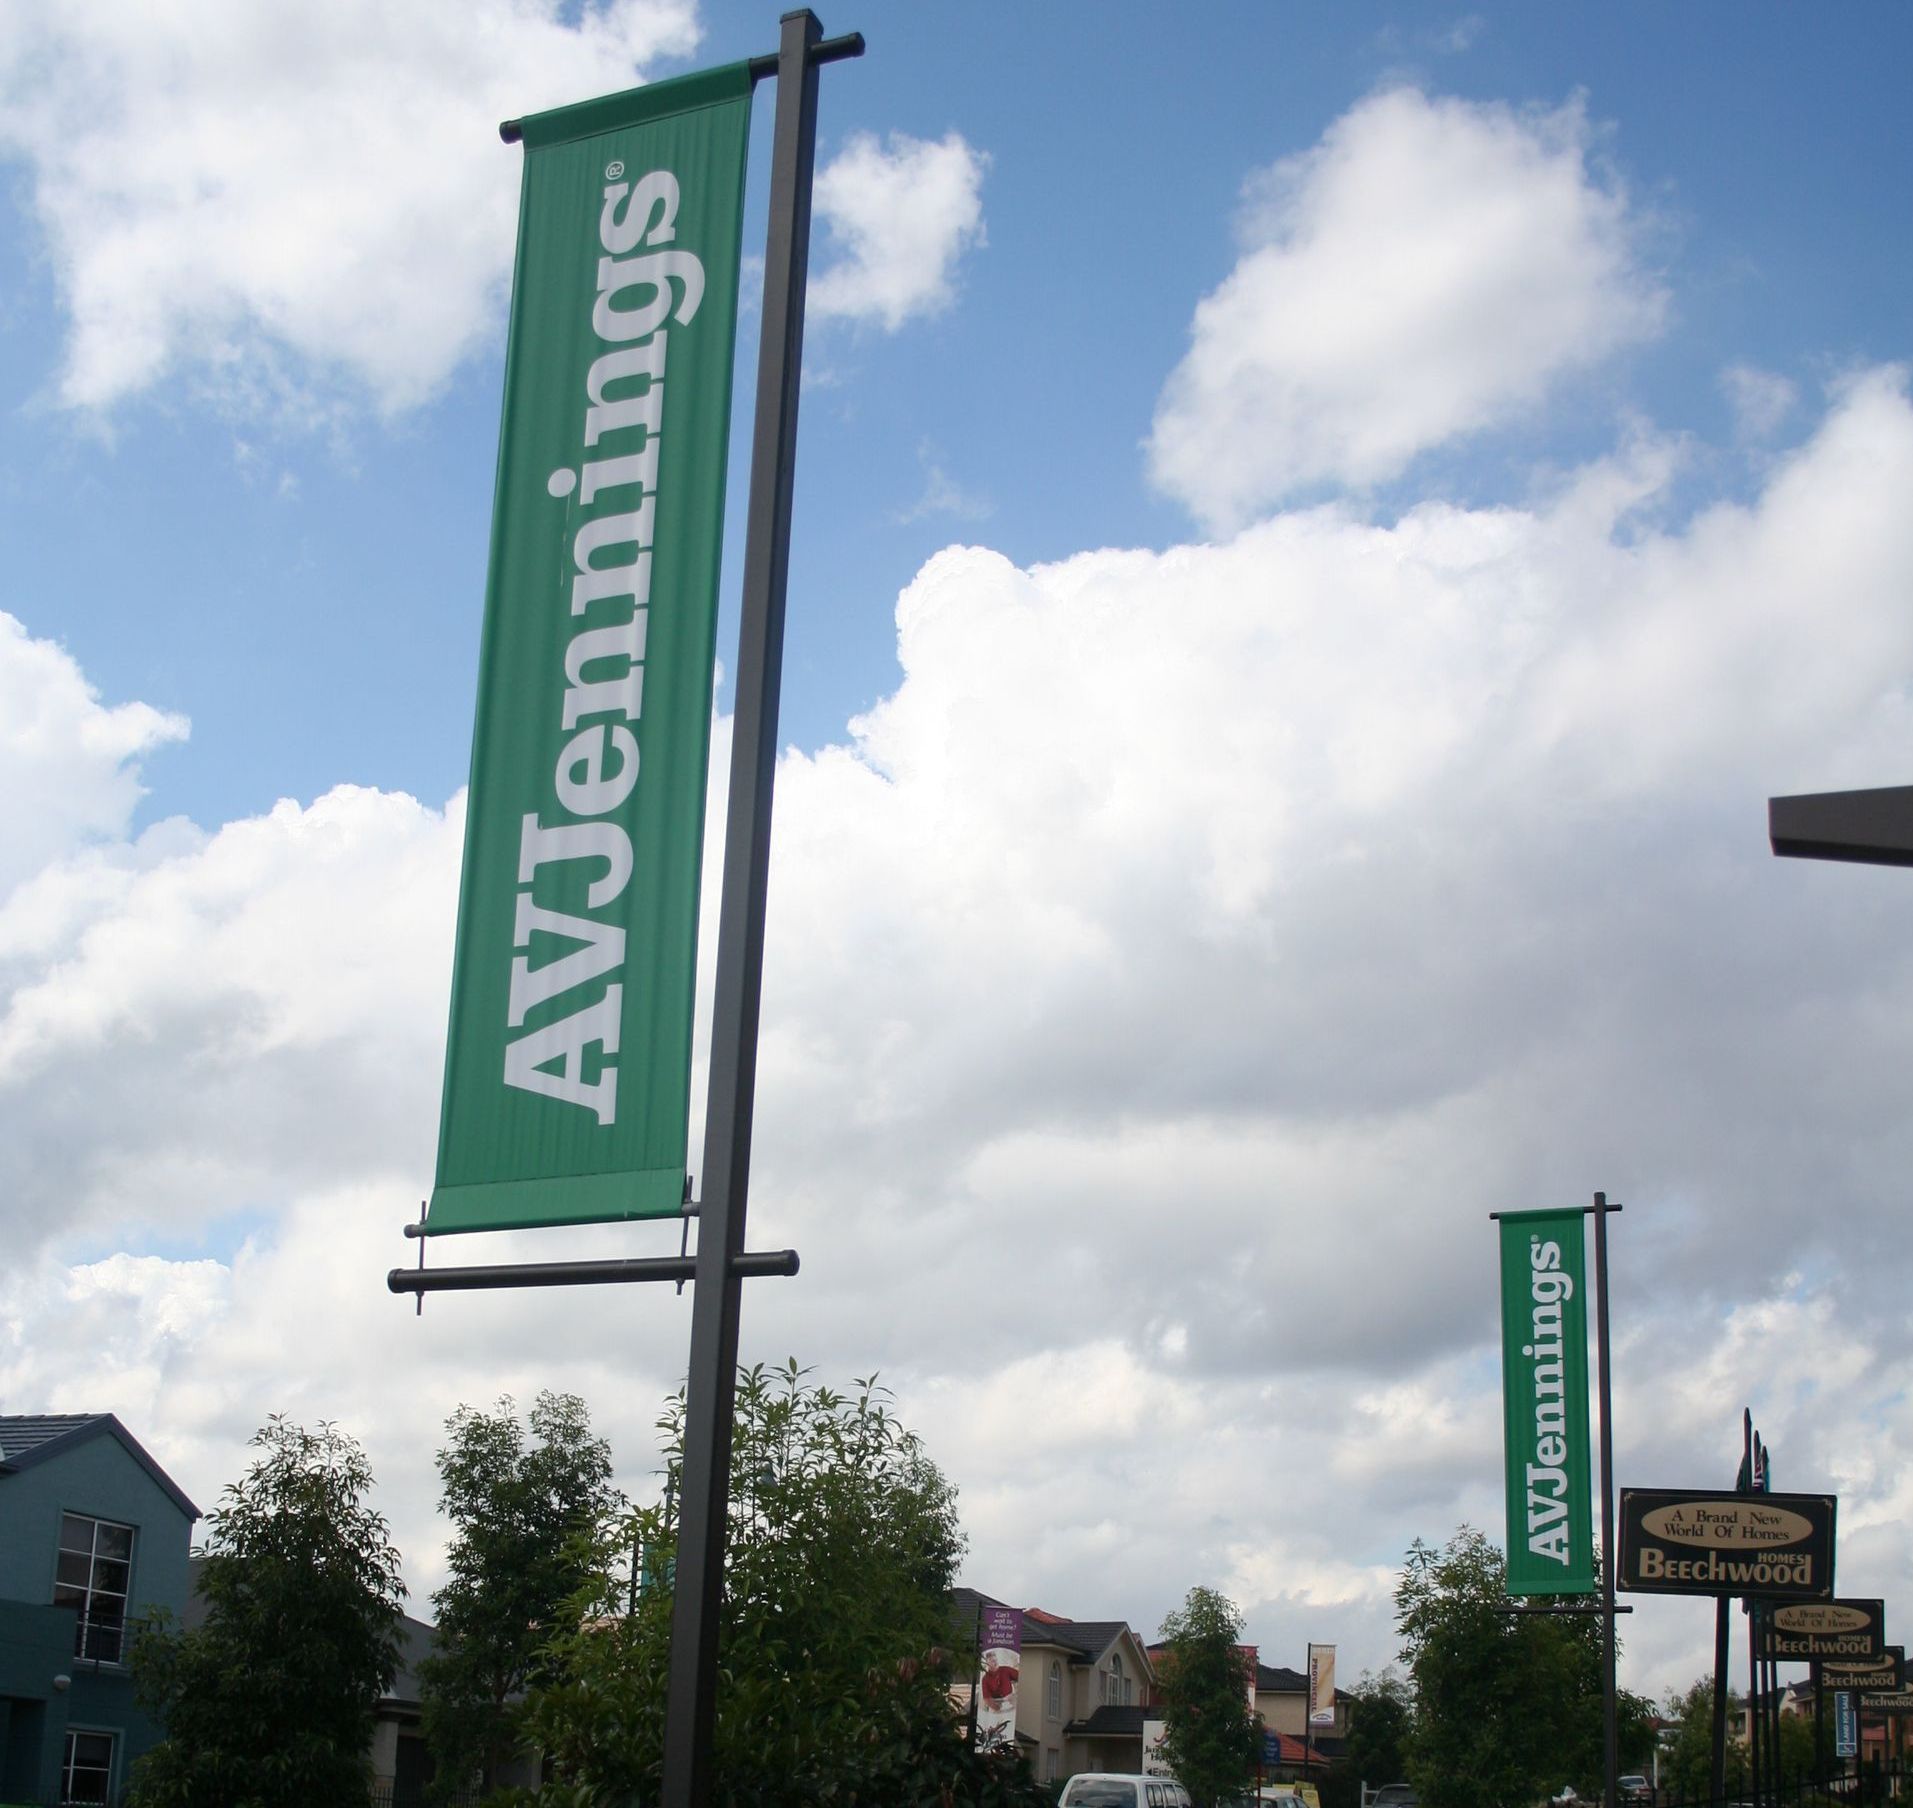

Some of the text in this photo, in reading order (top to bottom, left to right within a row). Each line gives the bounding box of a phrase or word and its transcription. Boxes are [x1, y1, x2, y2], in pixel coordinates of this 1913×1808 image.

[1671, 1509, 1782, 1525] A Brand New
[1664, 1523, 1790, 1540] World Of Homes
[1757, 1553, 1805, 1564] HOMES
[1800, 1610, 1825, 1618] Brand
[1832, 1610, 1852, 1618] New
[1780, 1618, 1805, 1627] World
[1828, 1619, 1857, 1627] Homes
[1311, 1658, 1319, 1712] PROVINCIAL
